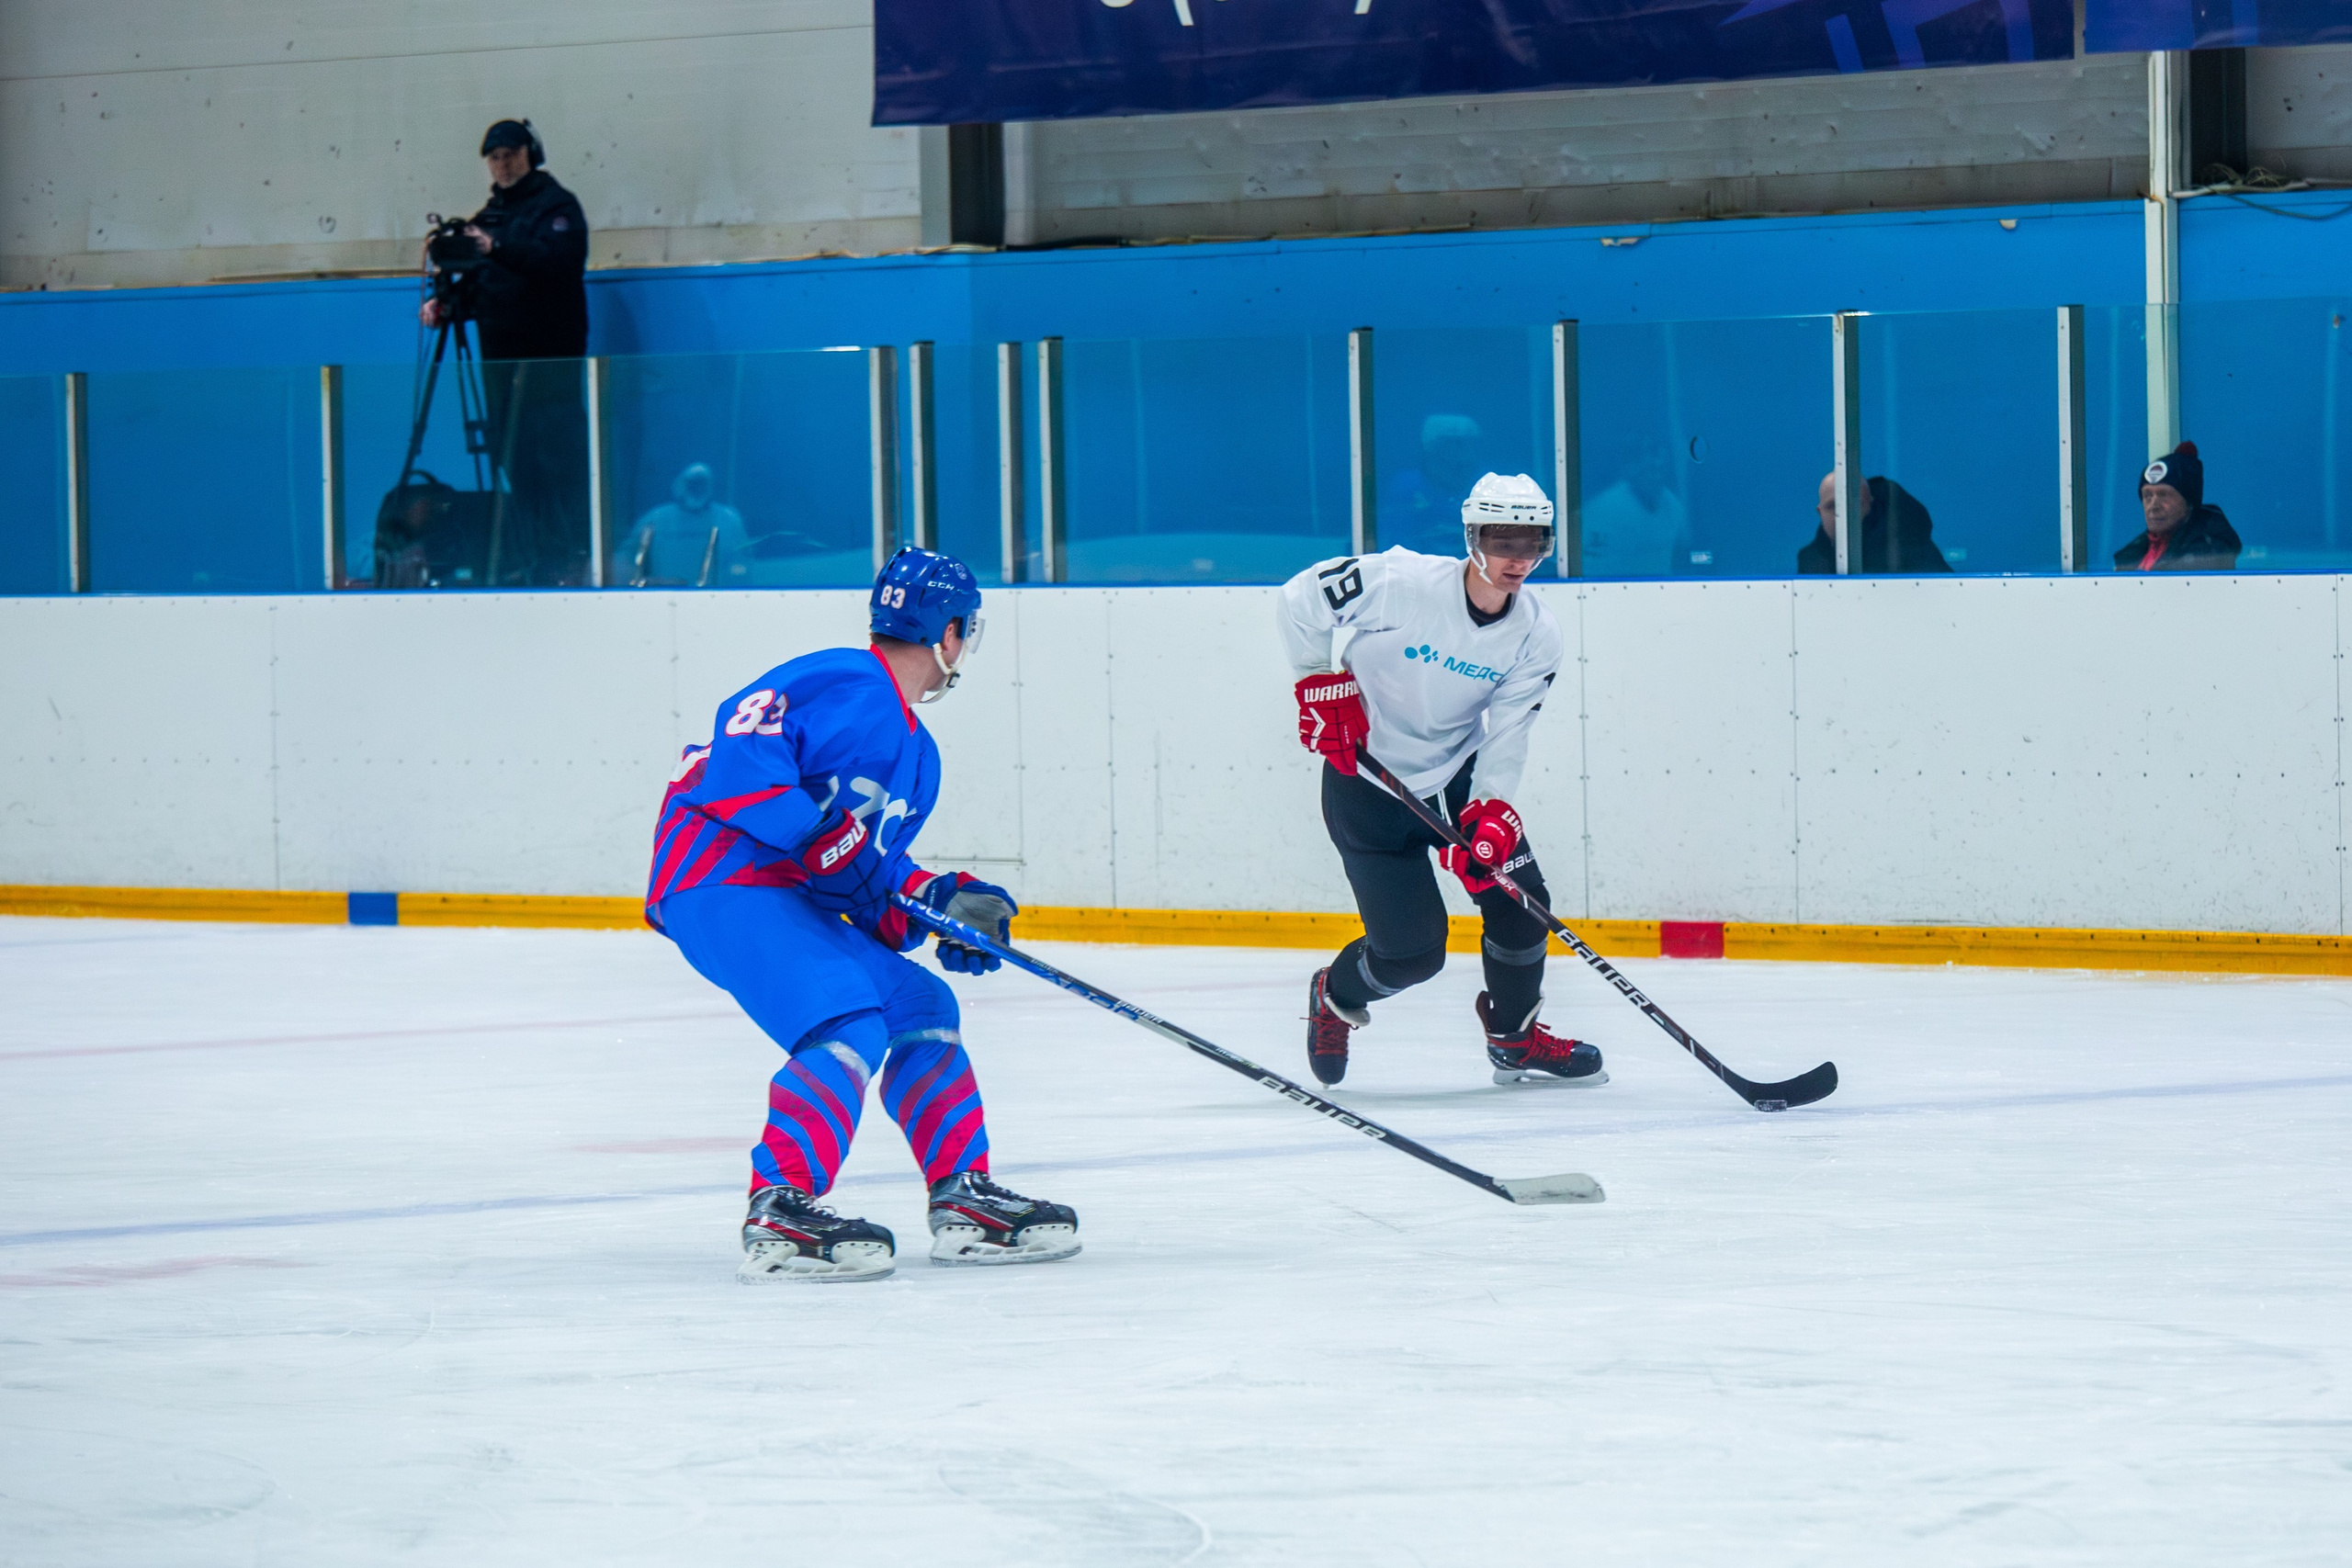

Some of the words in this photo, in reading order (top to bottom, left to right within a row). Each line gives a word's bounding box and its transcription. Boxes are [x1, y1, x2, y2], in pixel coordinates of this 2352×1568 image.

[880, 584, 906, 609] 83
[927, 581, 955, 591] CCM
[1317, 558, 1363, 611] 19
[1555, 928, 1651, 1010] BAUER
